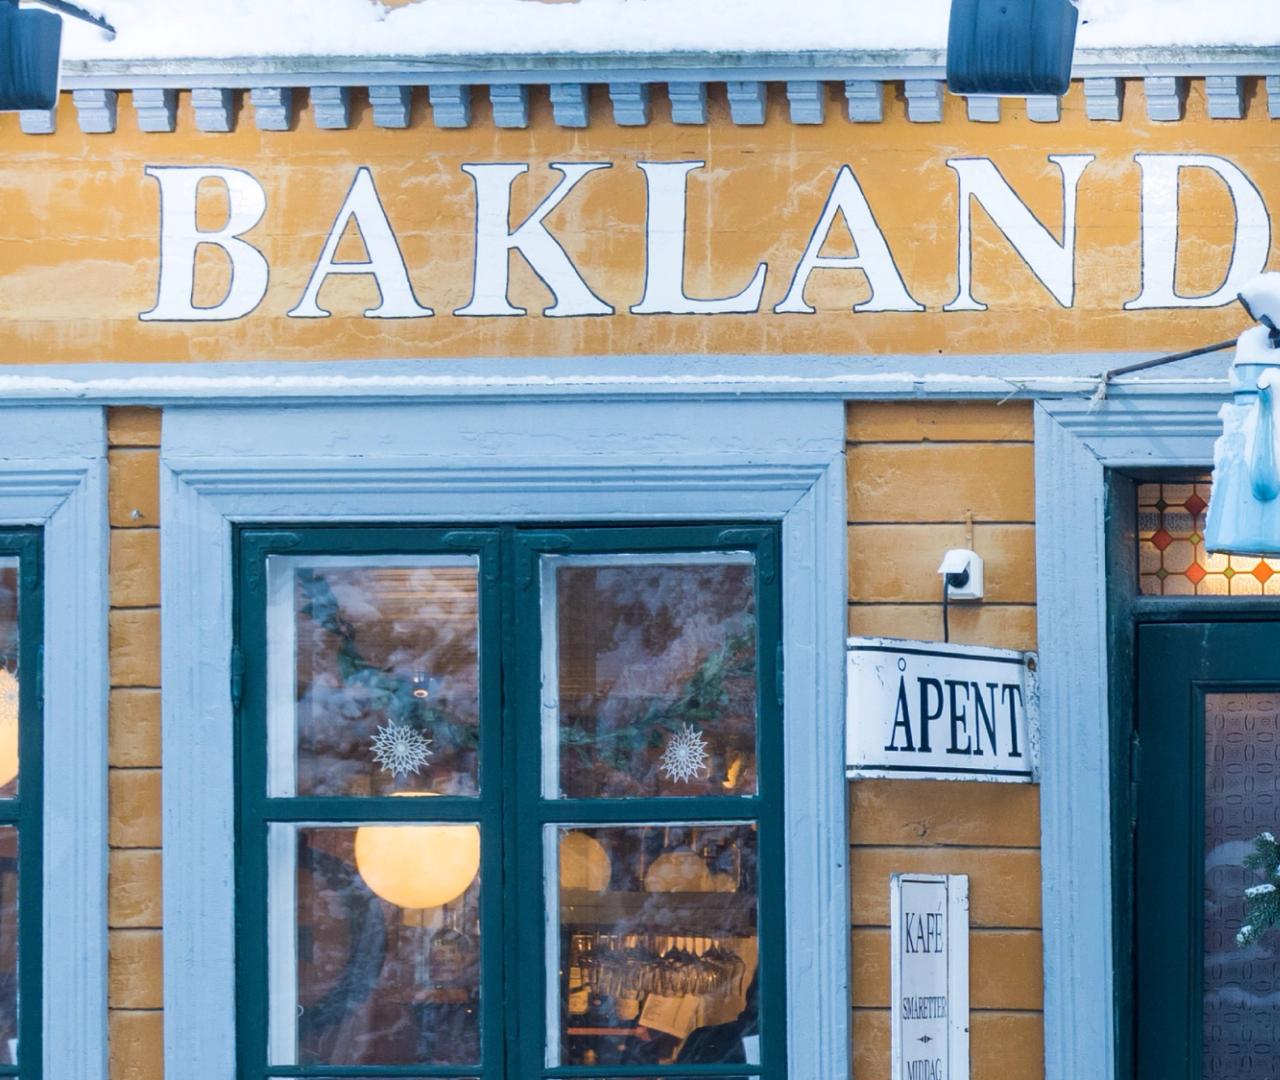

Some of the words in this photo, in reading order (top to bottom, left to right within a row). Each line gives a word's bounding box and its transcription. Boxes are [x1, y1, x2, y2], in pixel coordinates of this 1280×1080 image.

[884, 657, 1024, 758] ÅPENT
[905, 901, 943, 954] KAFÉ
[902, 995, 946, 1020] SMÅRETTER
